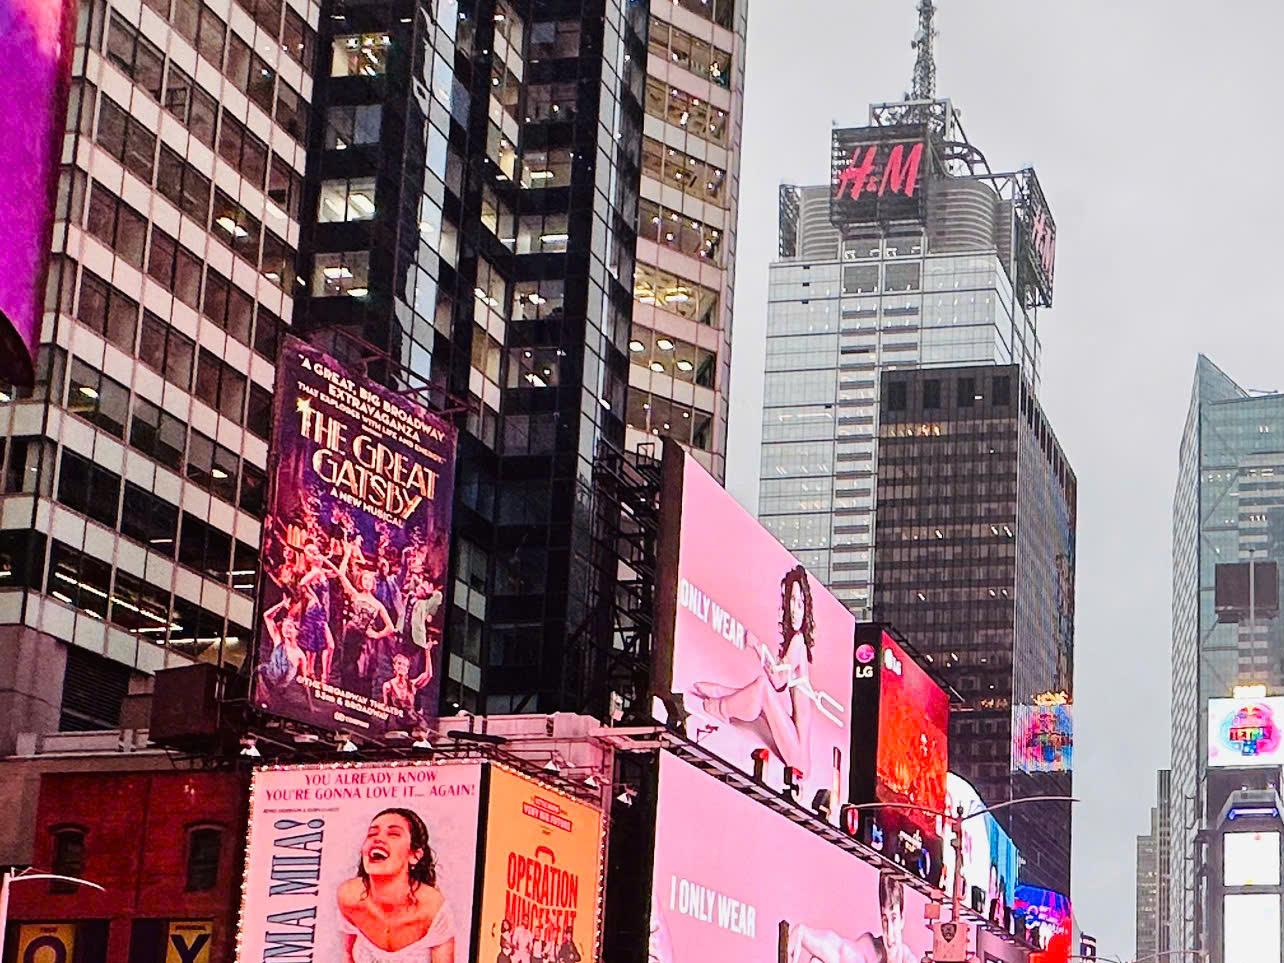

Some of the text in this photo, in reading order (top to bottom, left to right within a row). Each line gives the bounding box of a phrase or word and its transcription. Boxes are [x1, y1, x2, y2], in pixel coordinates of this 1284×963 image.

[835, 142, 924, 200] H&M
[328, 383, 420, 443] EXTRAVAGANZA
[359, 386, 380, 407] BIG
[383, 399, 446, 442] BROADWAY
[297, 402, 440, 500] THE GREAT
[312, 449, 423, 519] GATSBY
[339, 490, 362, 508] NEW
[680, 578, 747, 650] ONLY WEAR
[855, 666, 873, 678] LG
[266, 789, 310, 801] YOU'RE
[315, 786, 361, 800] GONNA
[366, 786, 398, 799] LOVE
[430, 784, 475, 797] AGAIN!
[305, 770, 437, 786] YOU ALREADY KNOW
[269, 818, 325, 897] MIA!
[507, 851, 579, 909] OPERATION
[670, 875, 757, 939] I ONLY WEAR
